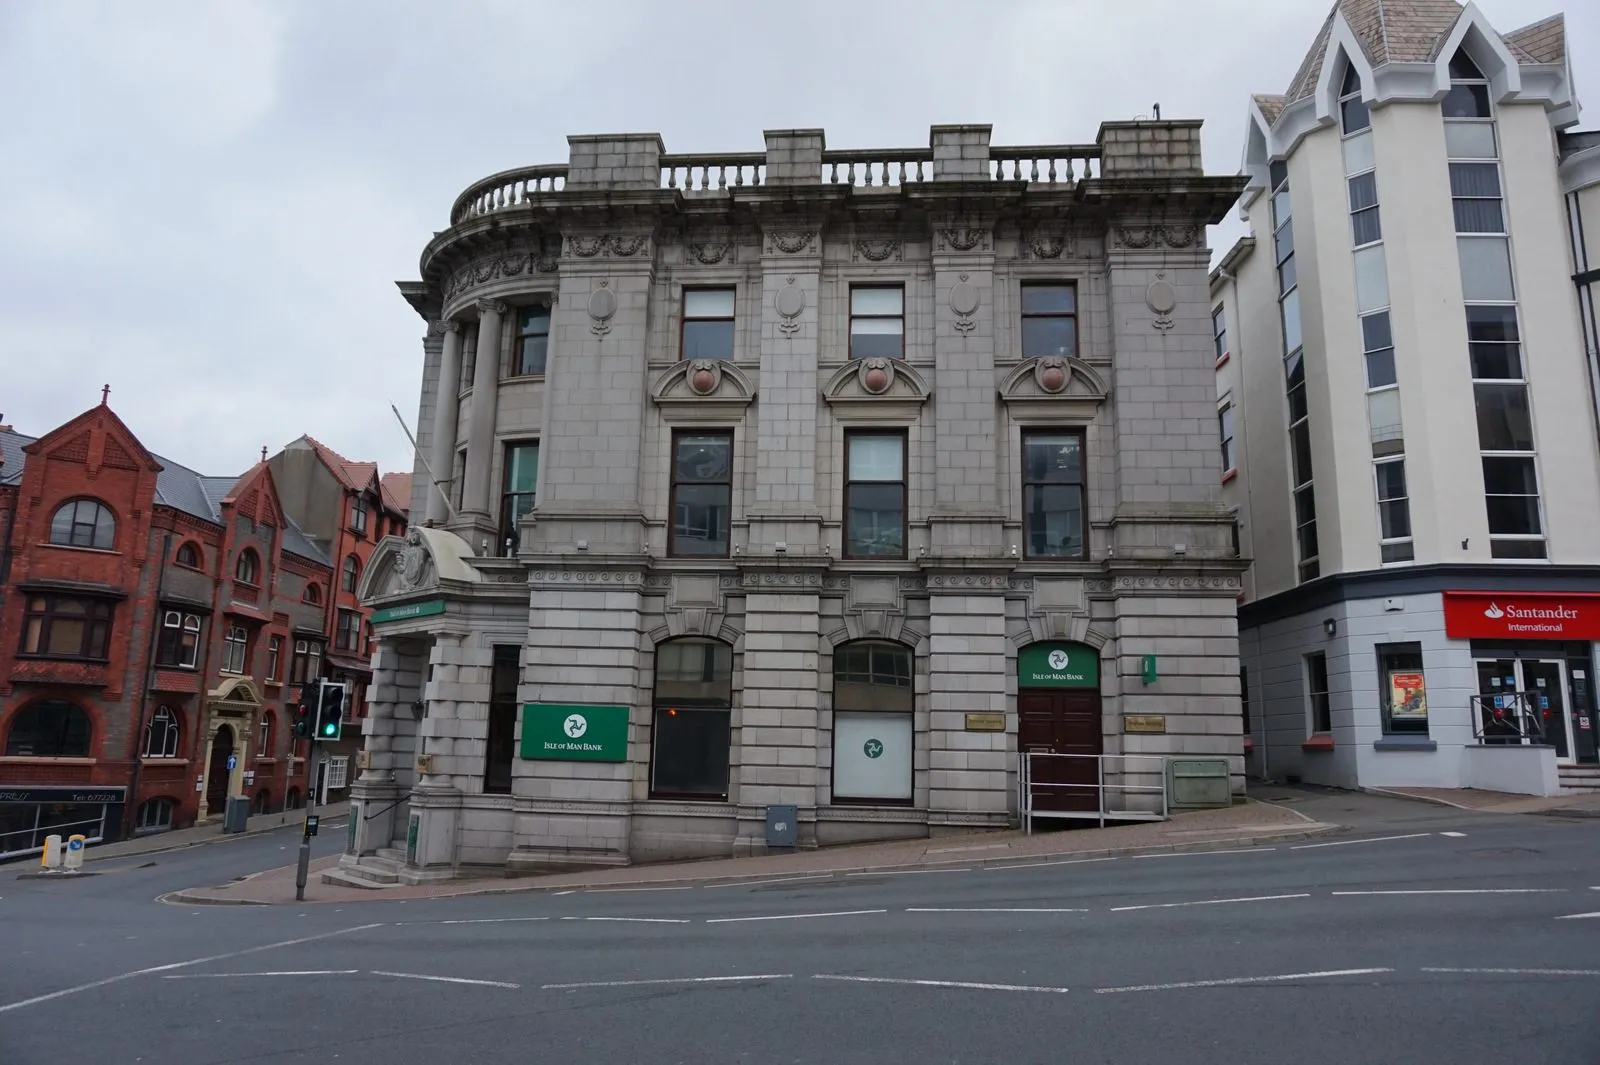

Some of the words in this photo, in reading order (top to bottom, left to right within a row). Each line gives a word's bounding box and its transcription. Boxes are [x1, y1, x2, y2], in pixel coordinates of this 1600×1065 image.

[1506, 605, 1578, 618] Santander
[1508, 623, 1562, 632] International
[544, 741, 558, 750] ISLE
[566, 742, 583, 751] MAN
[583, 743, 602, 752] BANK
